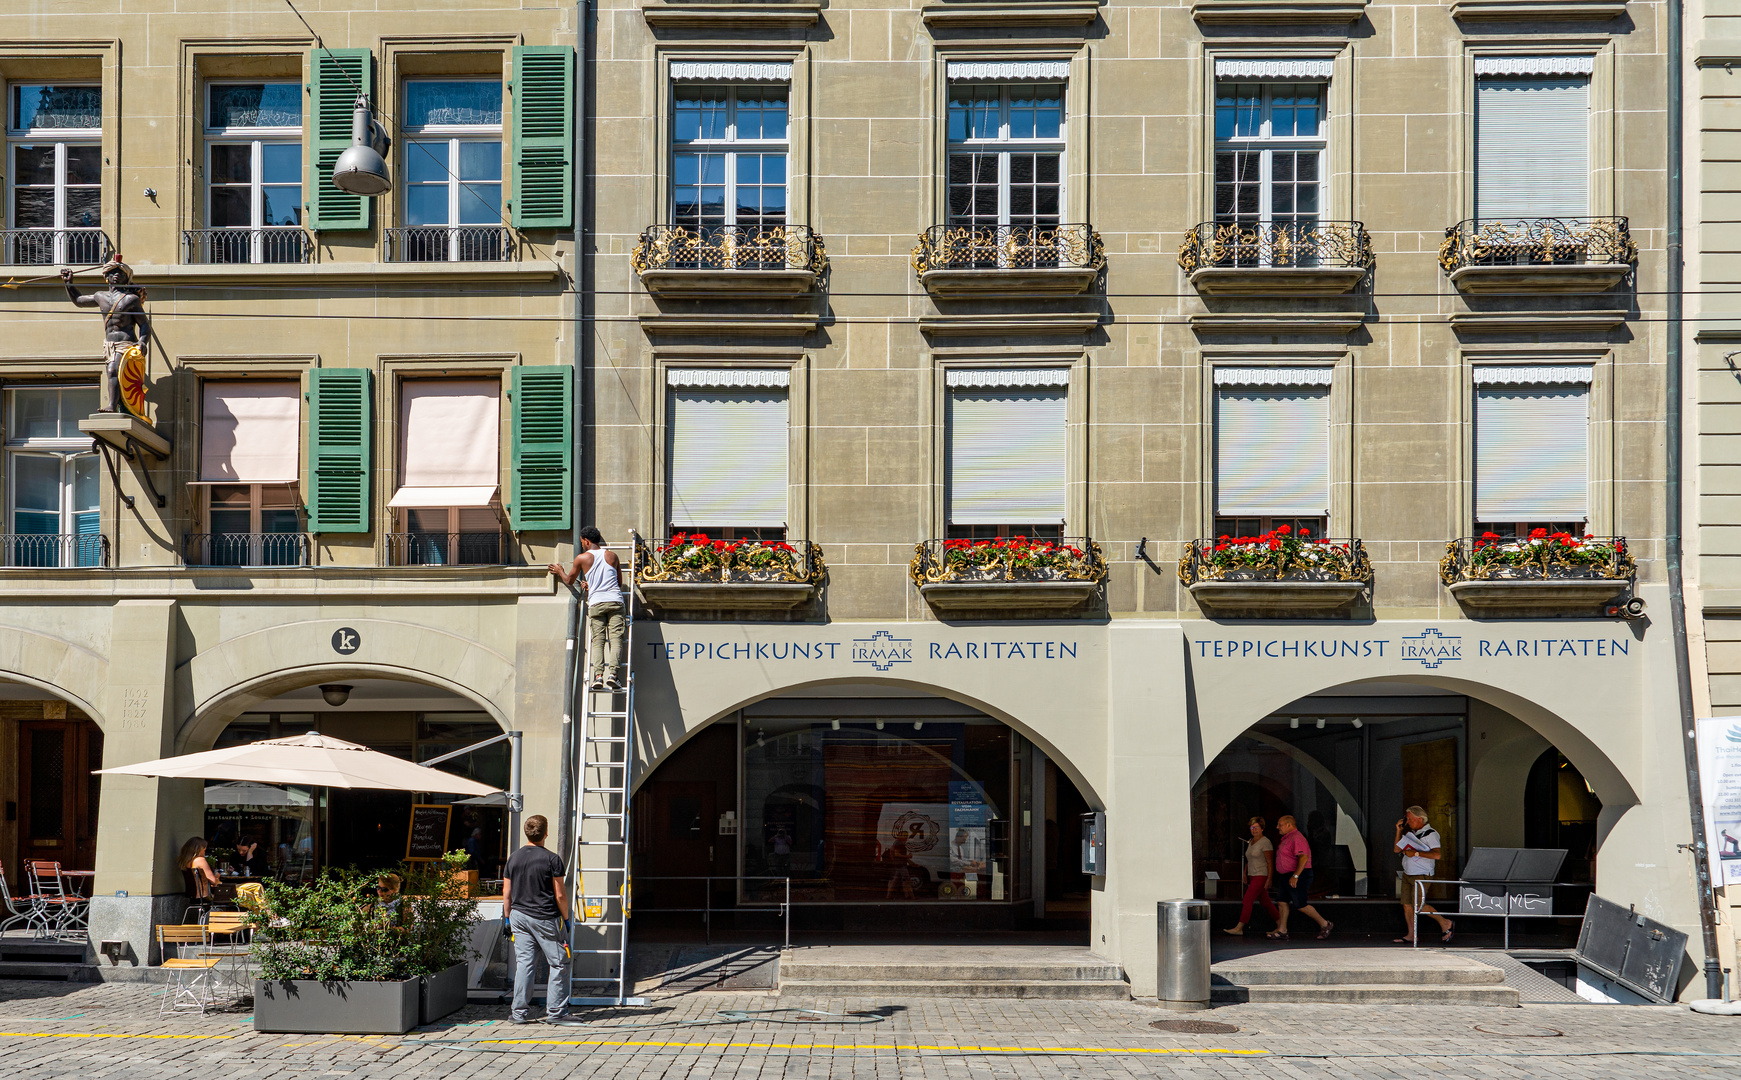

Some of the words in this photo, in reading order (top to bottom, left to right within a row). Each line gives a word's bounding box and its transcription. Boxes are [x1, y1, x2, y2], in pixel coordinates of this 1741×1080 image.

[647, 642, 841, 660] TEPPICHKUNST
[929, 641, 1077, 659] RARITÄTEN
[1195, 640, 1390, 658] TEPPICHKUNST
[1401, 645, 1462, 658] IRMAK
[1479, 638, 1629, 657] RARITÄTEN
[852, 648, 913, 660] IRMAK
[124, 688, 149, 698] 1692
[124, 699, 148, 708] 1747
[123, 709, 147, 718] 1827
[122, 719, 146, 729] 1986
